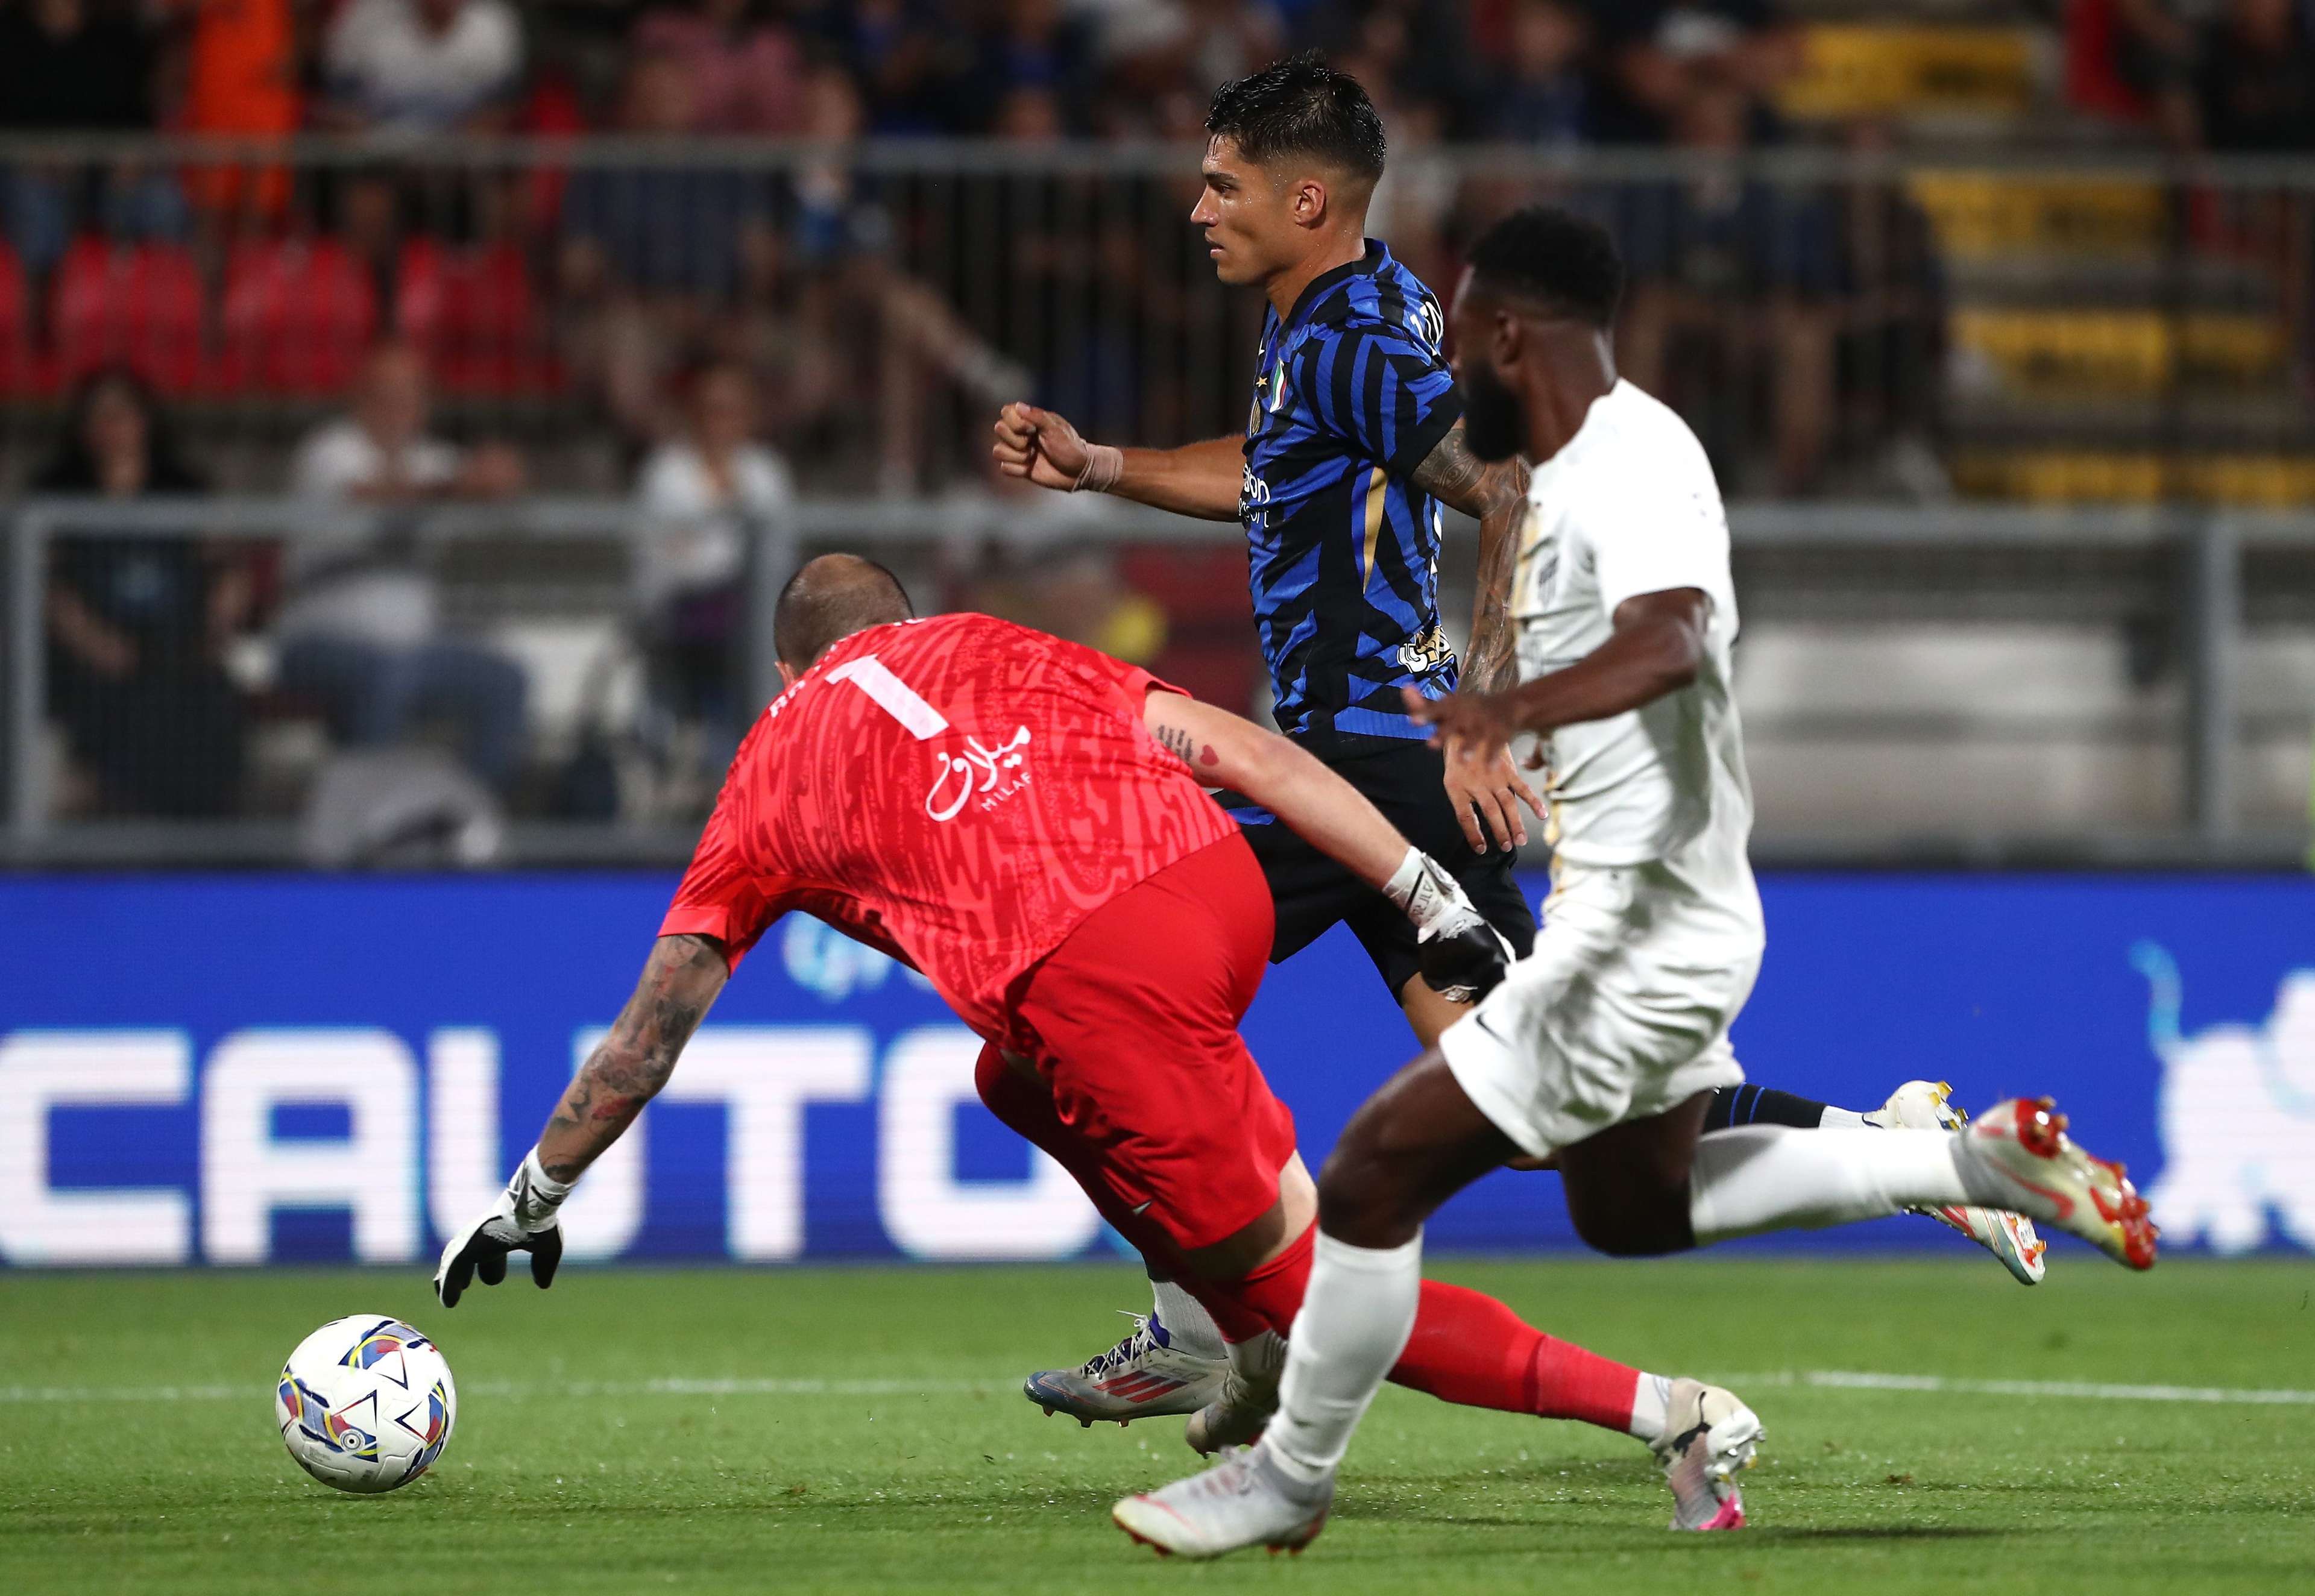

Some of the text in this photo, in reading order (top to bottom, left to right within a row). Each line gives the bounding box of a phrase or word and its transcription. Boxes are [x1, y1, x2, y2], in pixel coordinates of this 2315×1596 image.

[824, 653, 949, 741] 1
[980, 771, 1032, 812] MILAF
[0, 1026, 1104, 1263] CAUTO
